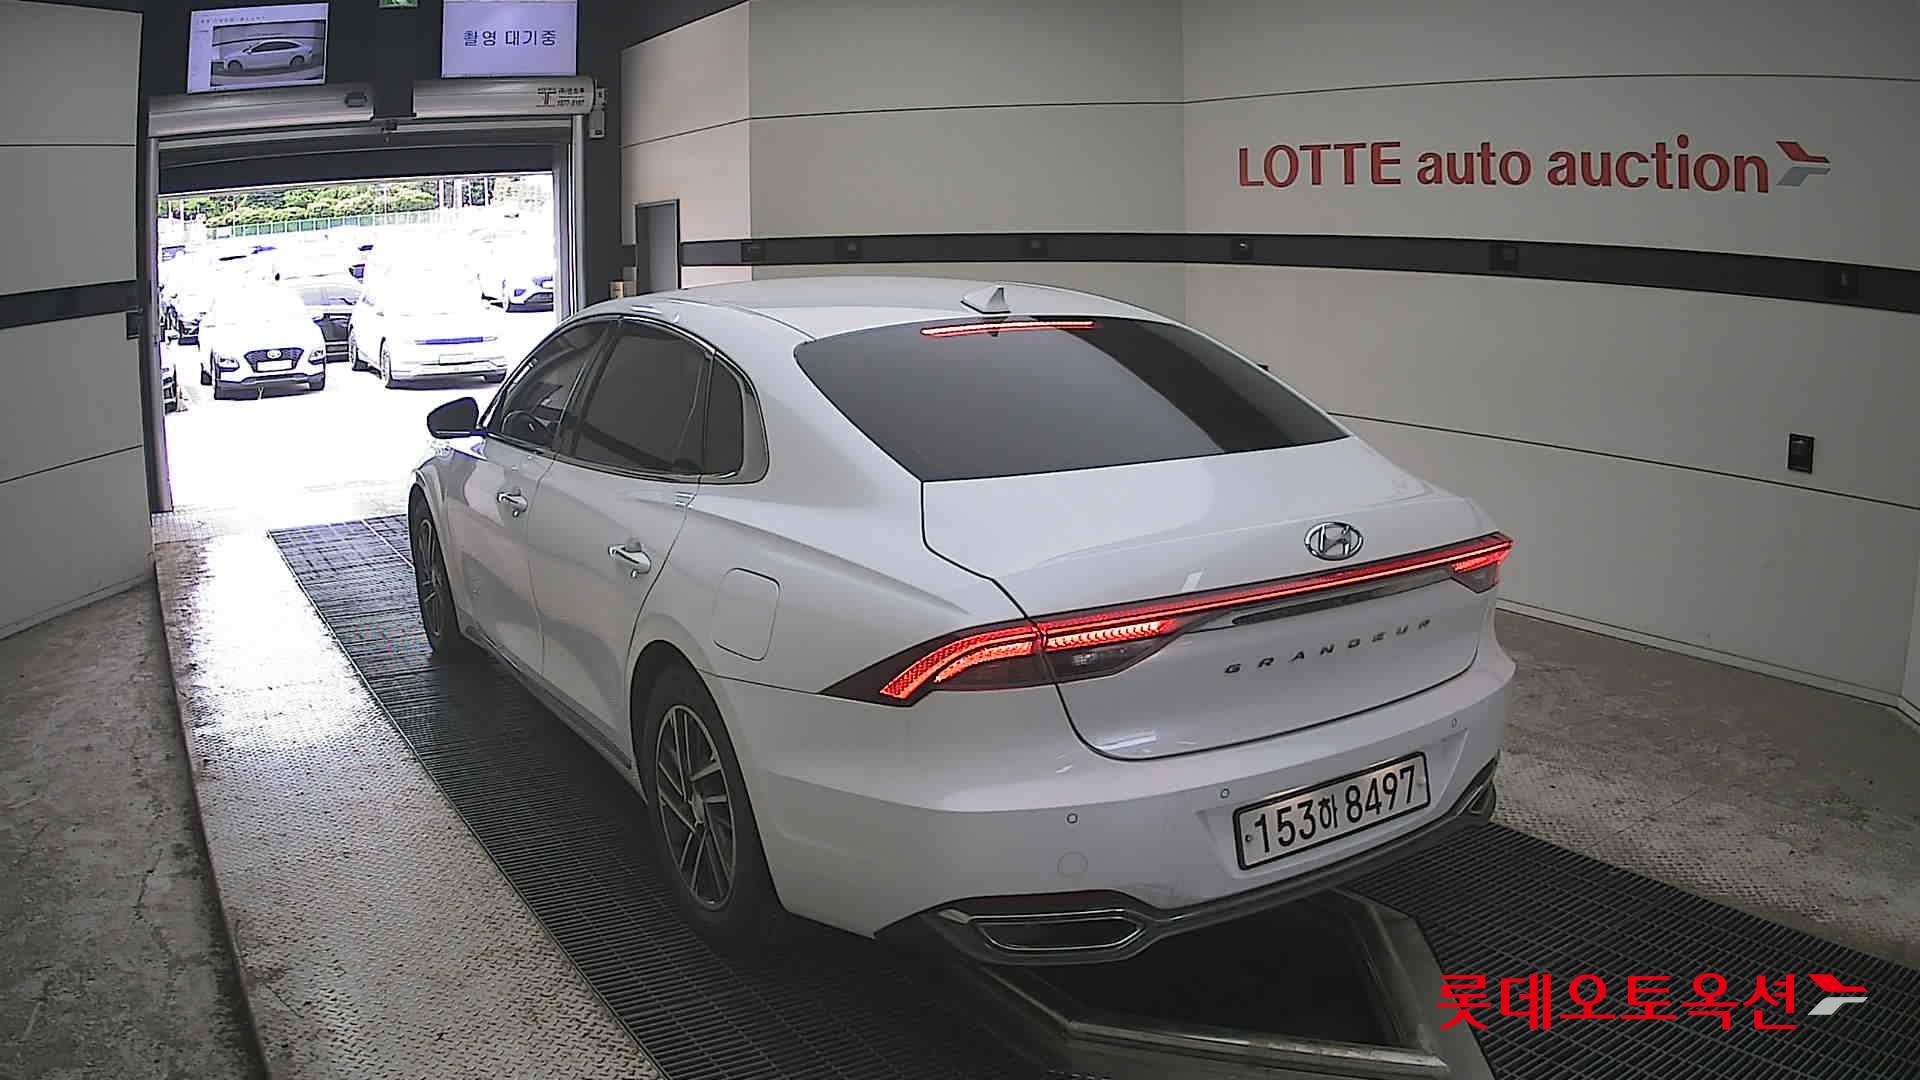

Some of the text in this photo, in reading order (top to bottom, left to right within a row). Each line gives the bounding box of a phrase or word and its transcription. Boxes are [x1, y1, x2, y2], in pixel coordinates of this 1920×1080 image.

[463, 29, 557, 47] 촬영 대기중
[1239, 134, 1769, 194] LOTTE auto auction
[1224, 619, 1431, 674] GRANDEUR
[1254, 765, 1415, 853] 153하 8497
